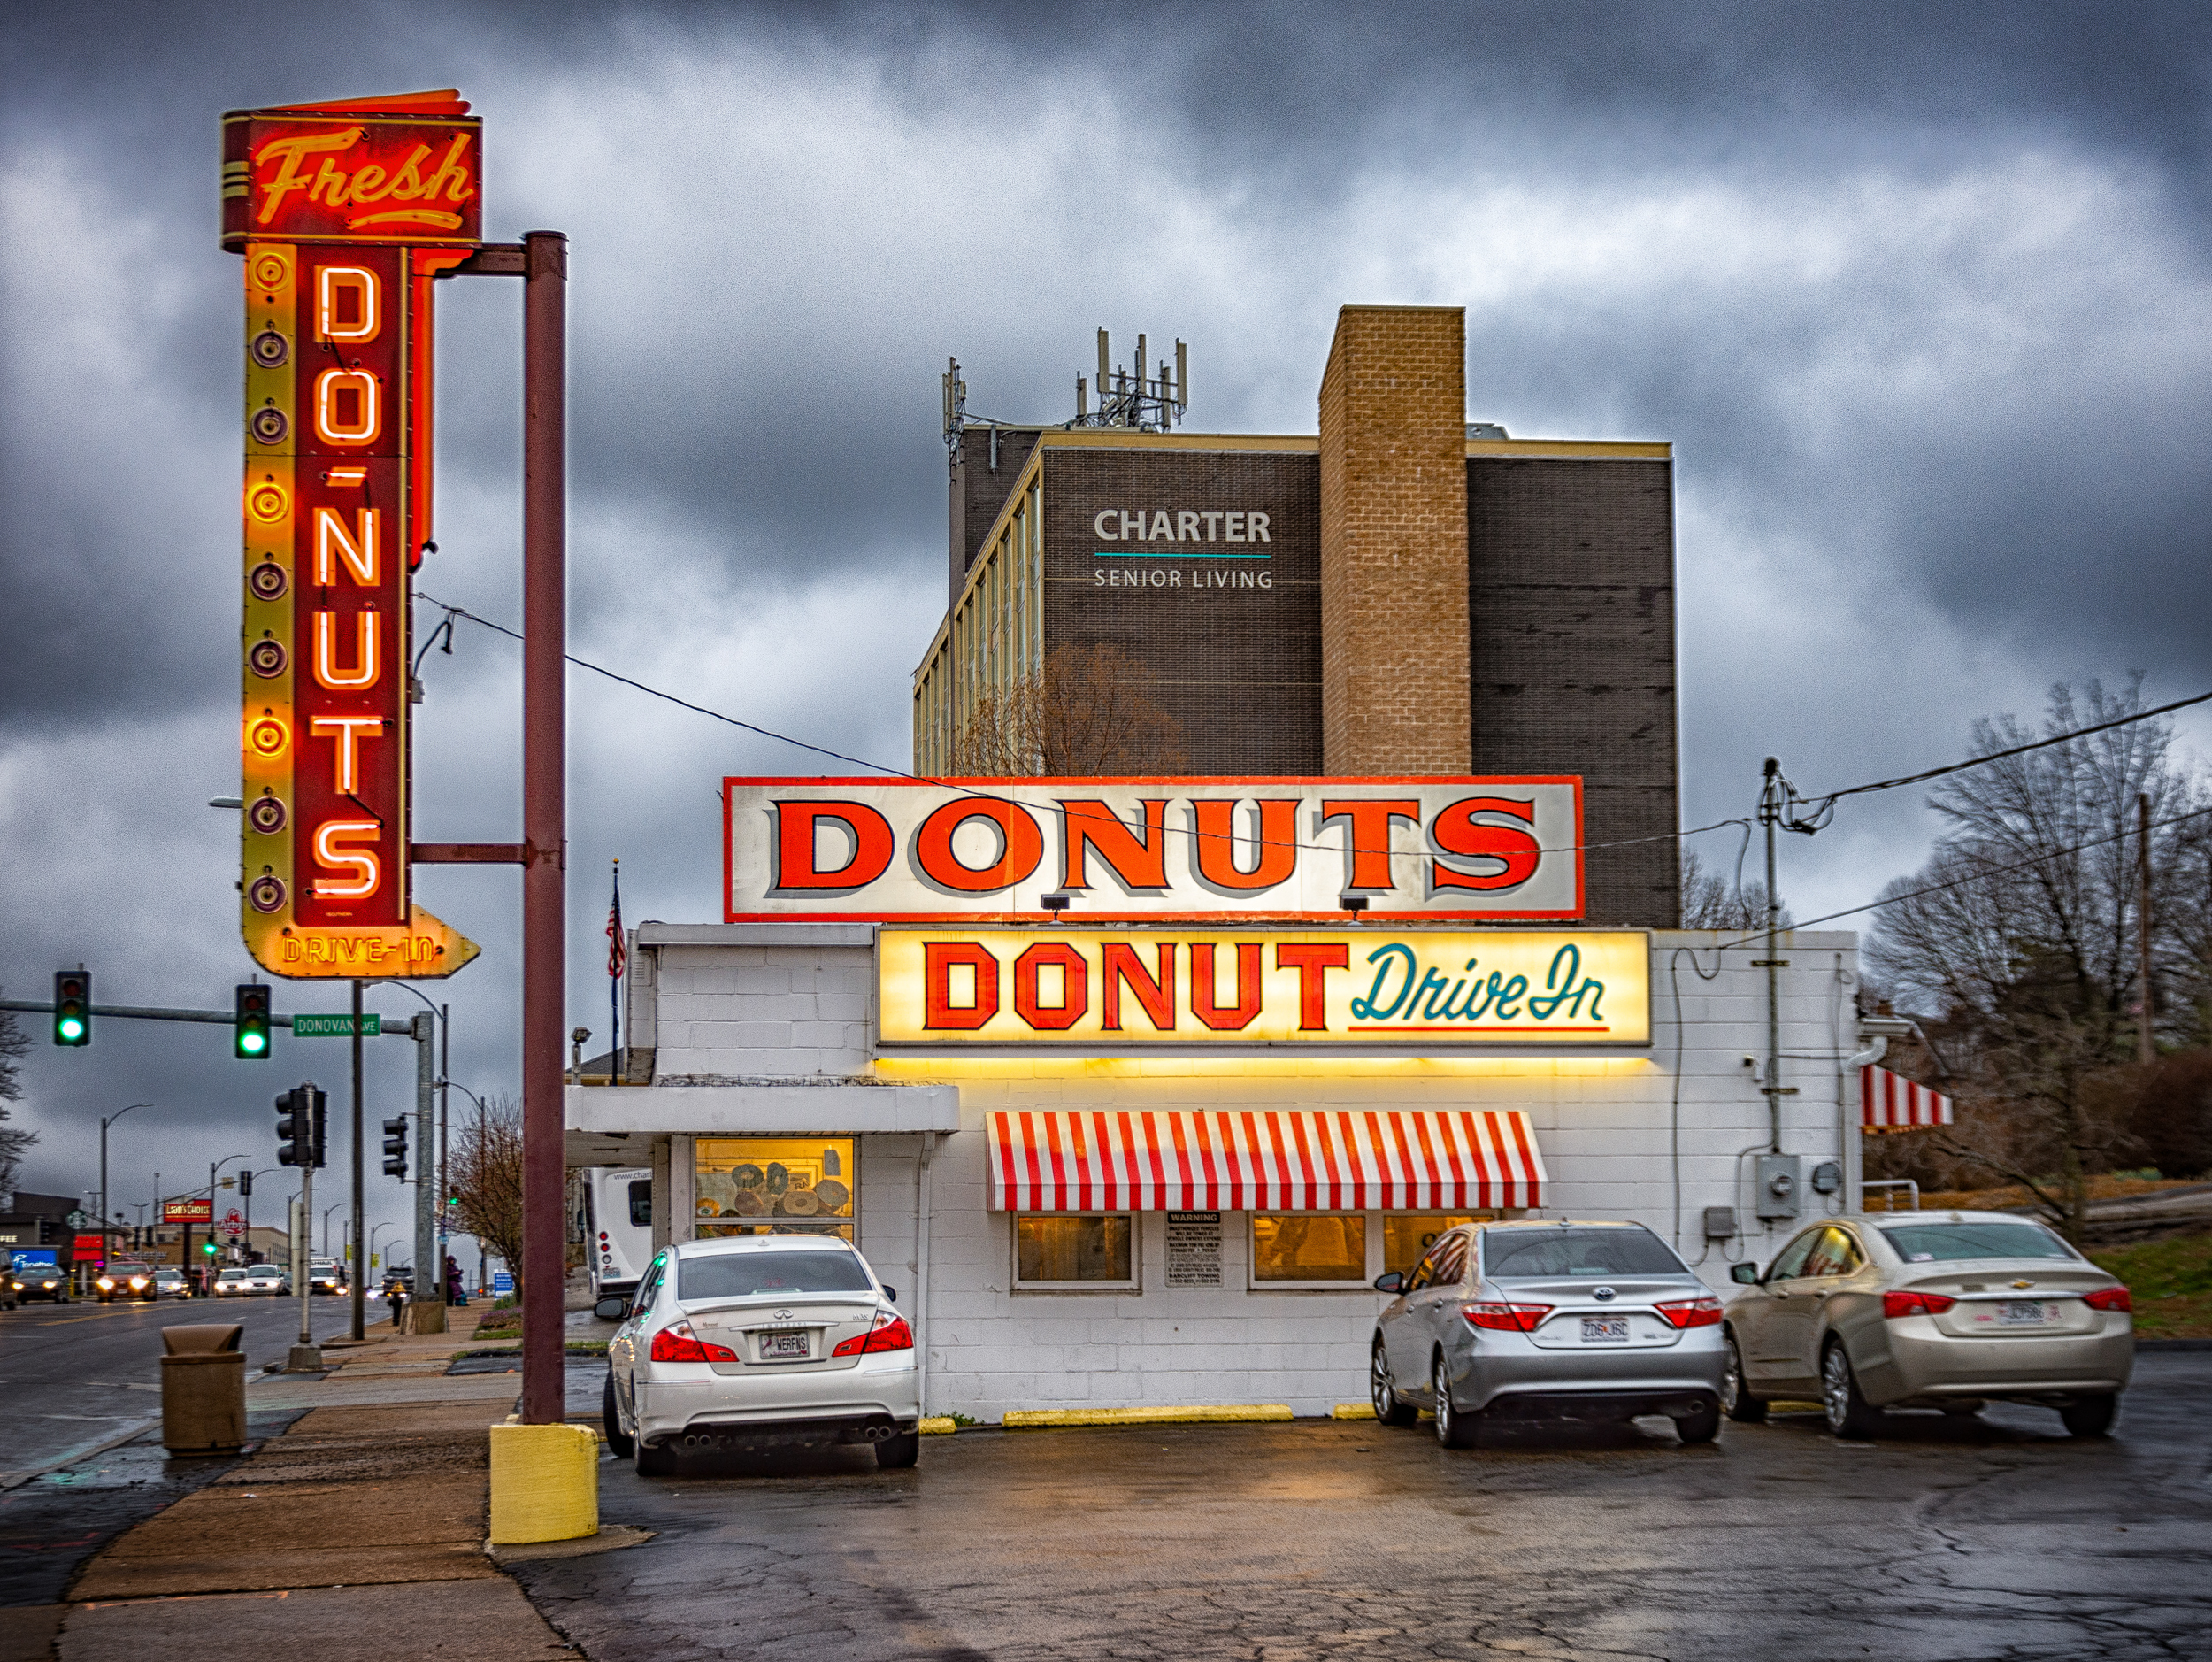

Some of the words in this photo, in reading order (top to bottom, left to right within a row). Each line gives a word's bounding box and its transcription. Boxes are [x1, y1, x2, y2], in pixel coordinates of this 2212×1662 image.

[256, 126, 474, 225] Fresh
[1094, 509, 1271, 542] CHARTER
[1094, 569, 1182, 588] SENIOR
[1193, 570, 1272, 589] LIVING
[768, 796, 1540, 897] DONUTS
[922, 942, 1350, 1031] DONUT
[1349, 943, 1529, 1021] Drive
[1531, 943, 1603, 1021] In
[298, 1020, 355, 1032] DONOVAN
[776, 1336, 806, 1350] WERFNS
